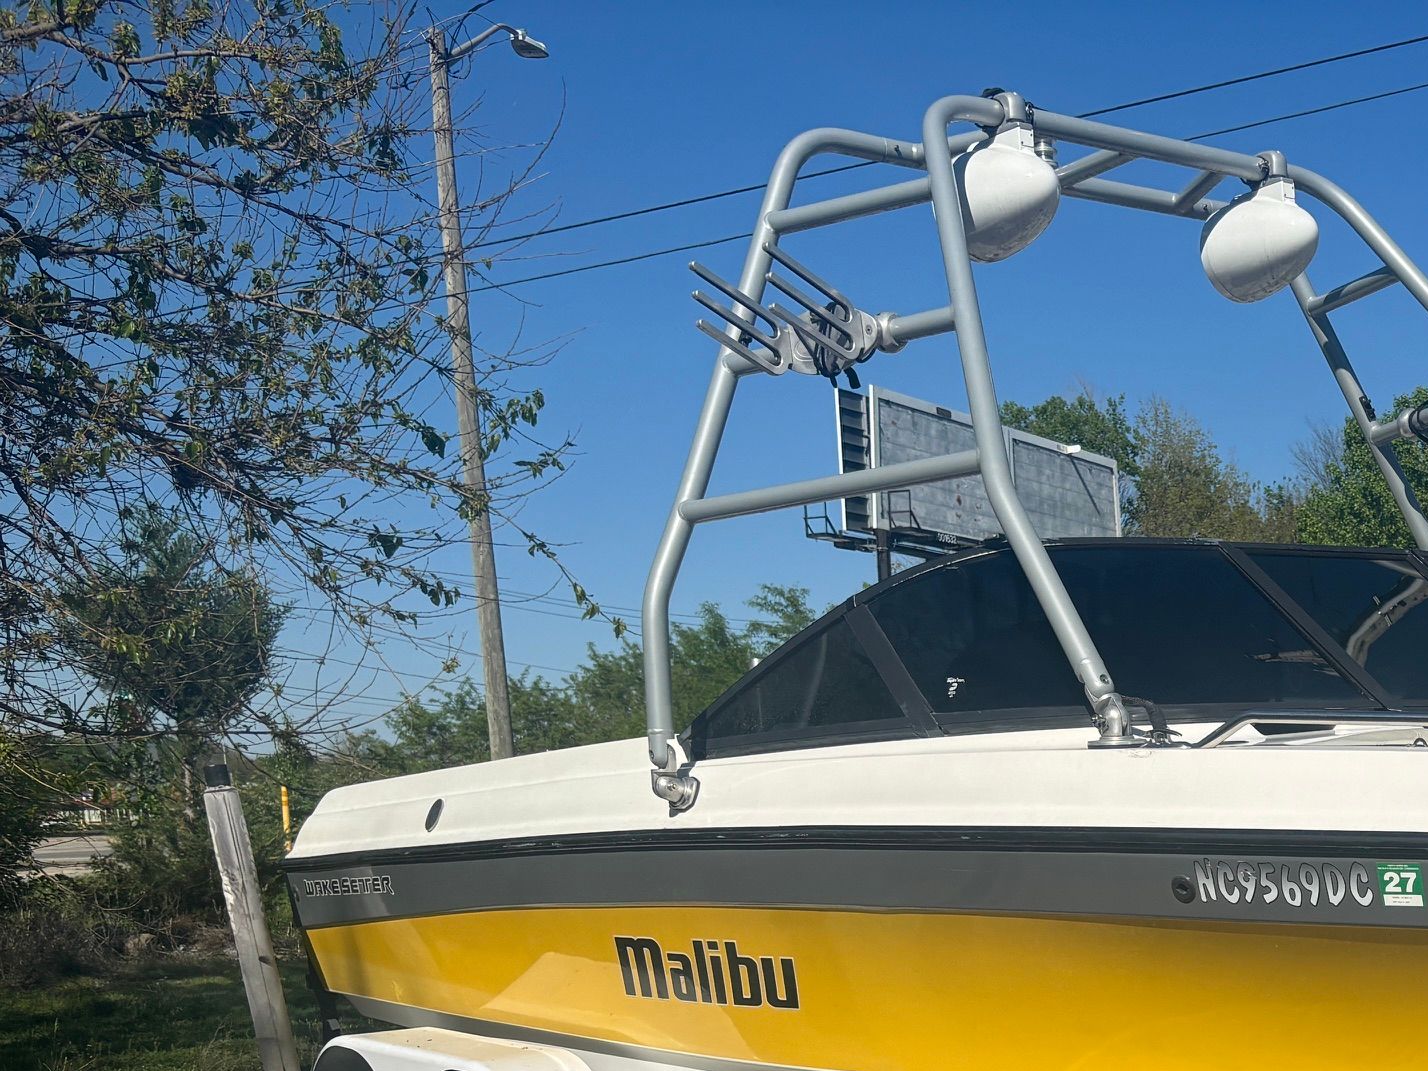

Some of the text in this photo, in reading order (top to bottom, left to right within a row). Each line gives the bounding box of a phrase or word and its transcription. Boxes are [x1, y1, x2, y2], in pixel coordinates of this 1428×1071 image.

[1194, 857, 1374, 907] NC9569DC
[1383, 871, 1417, 893] 27
[613, 935, 801, 1010] Malibu
